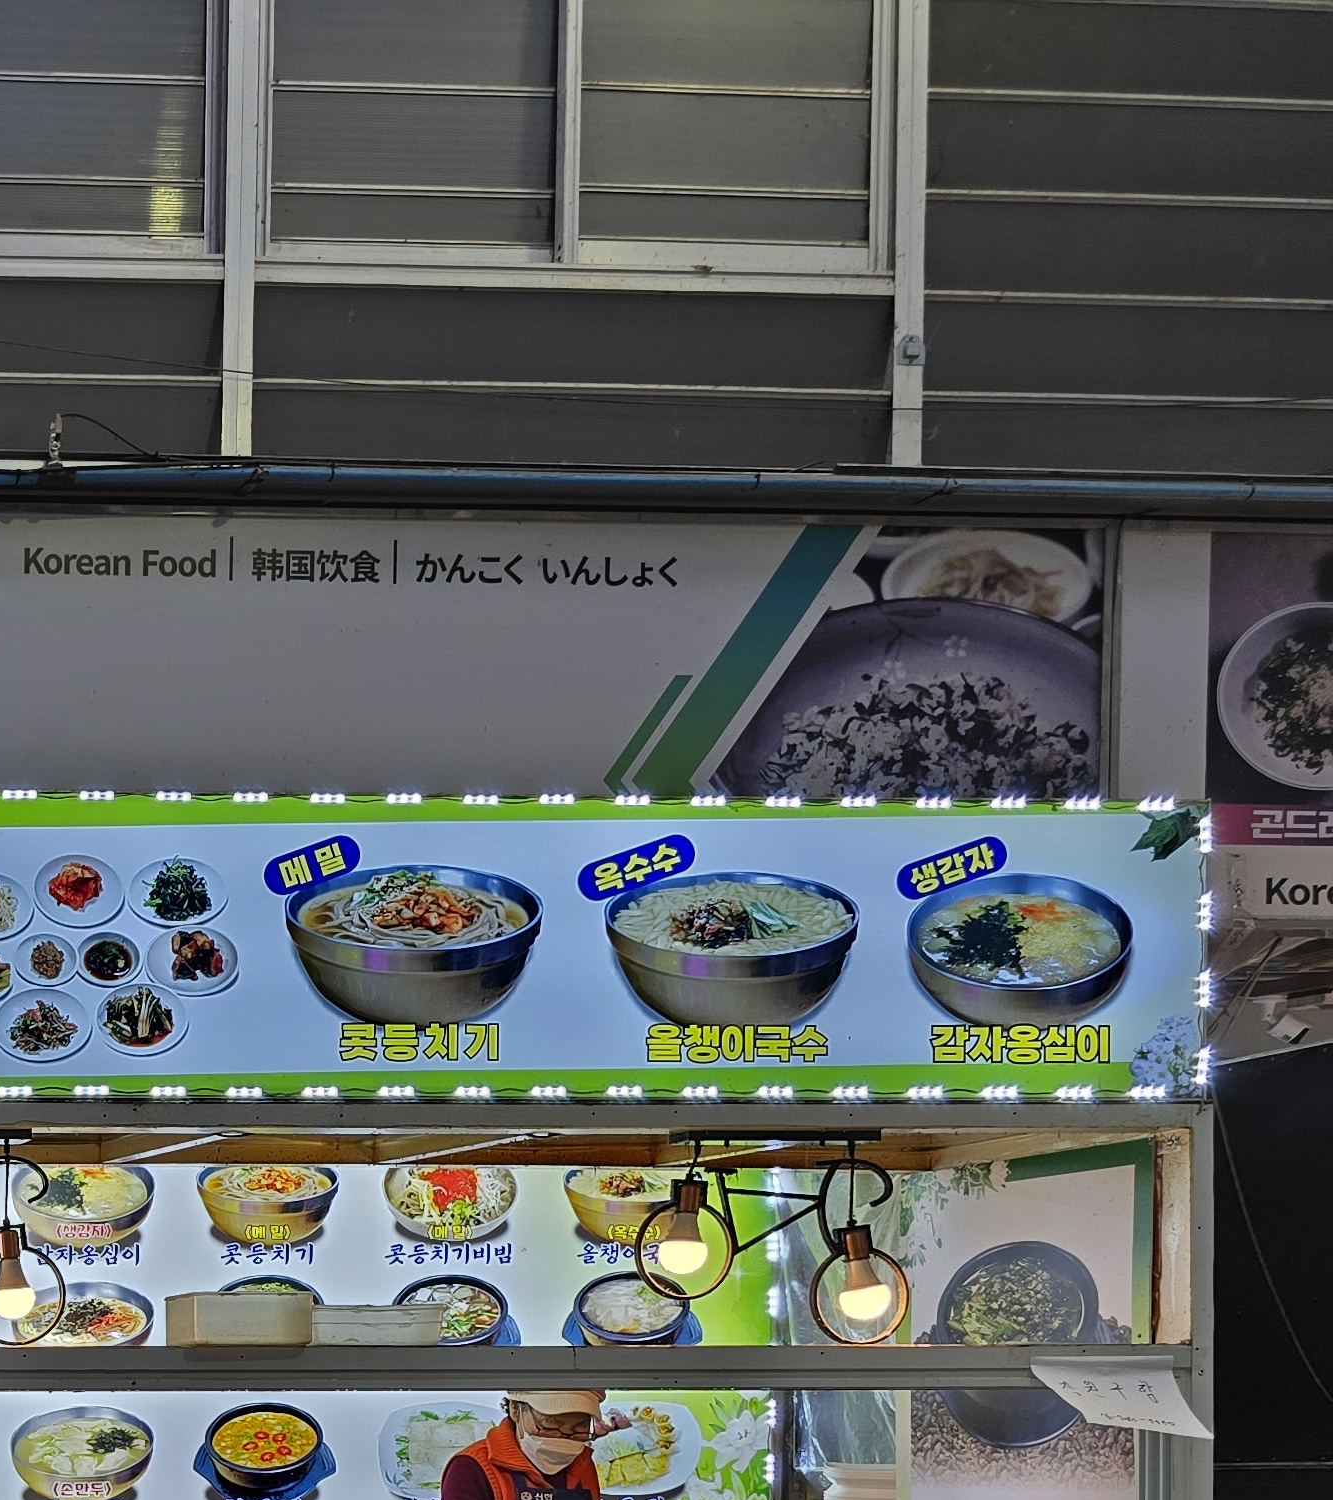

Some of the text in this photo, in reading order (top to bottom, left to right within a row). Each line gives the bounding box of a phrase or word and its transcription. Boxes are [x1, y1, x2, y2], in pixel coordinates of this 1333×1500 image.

[23, 547, 218, 579] Korean Food
[251, 548, 381, 583] 韩国饮食
[415, 552, 680, 588] かんこく いんしょく
[277, 841, 347, 891] 메밀
[592, 840, 681, 894] 옥수수
[908, 841, 998, 894] 생감자
[338, 1022, 500, 1062] 콧등치기
[645, 1021, 829, 1063] 올챙이국수
[930, 1022, 1112, 1064] 감자옹심이
[220, 1242, 315, 1266] 콧등치기
[384, 1242, 513, 1267] 콧등치기비빔
